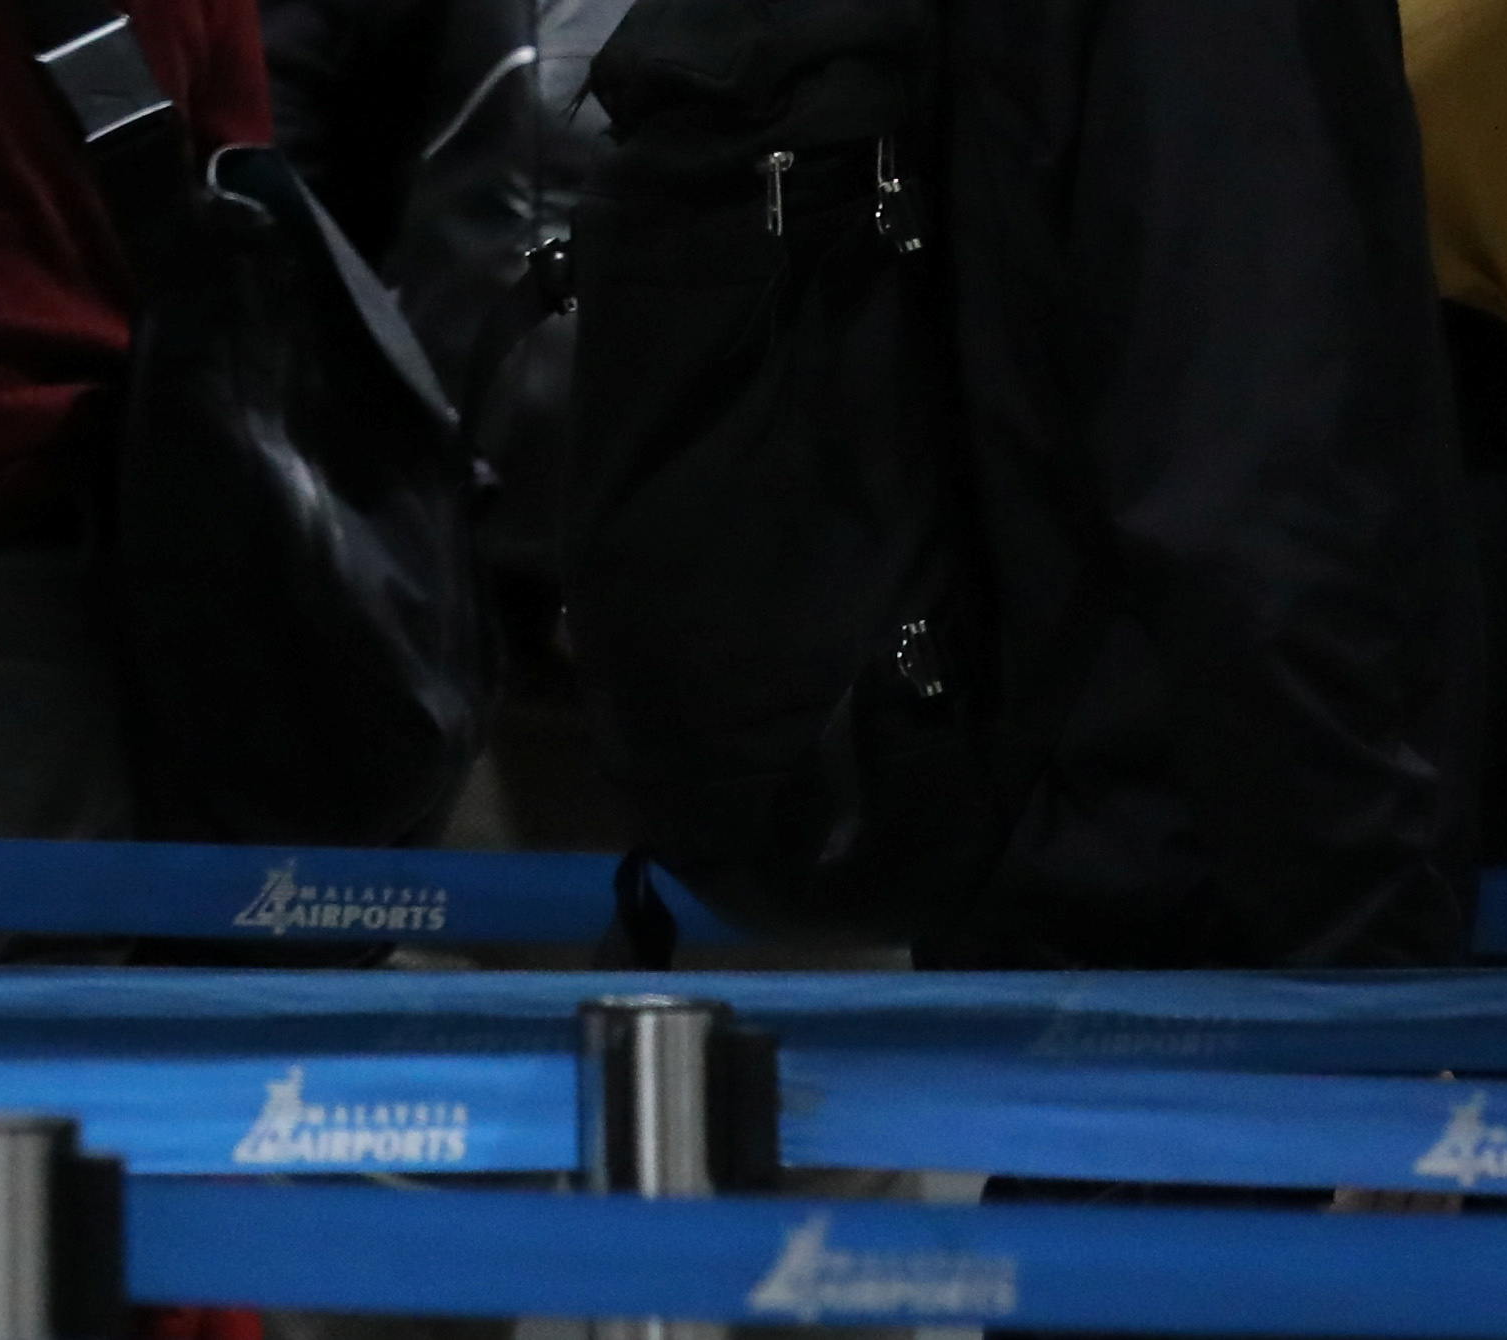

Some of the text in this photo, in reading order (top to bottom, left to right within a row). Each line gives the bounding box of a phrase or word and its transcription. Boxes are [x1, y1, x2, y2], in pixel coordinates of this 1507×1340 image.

[299, 884, 447, 904] MALAYSIA
[289, 904, 447, 931] AIRPORTS
[298, 1128, 467, 1163] AIRPORTS
